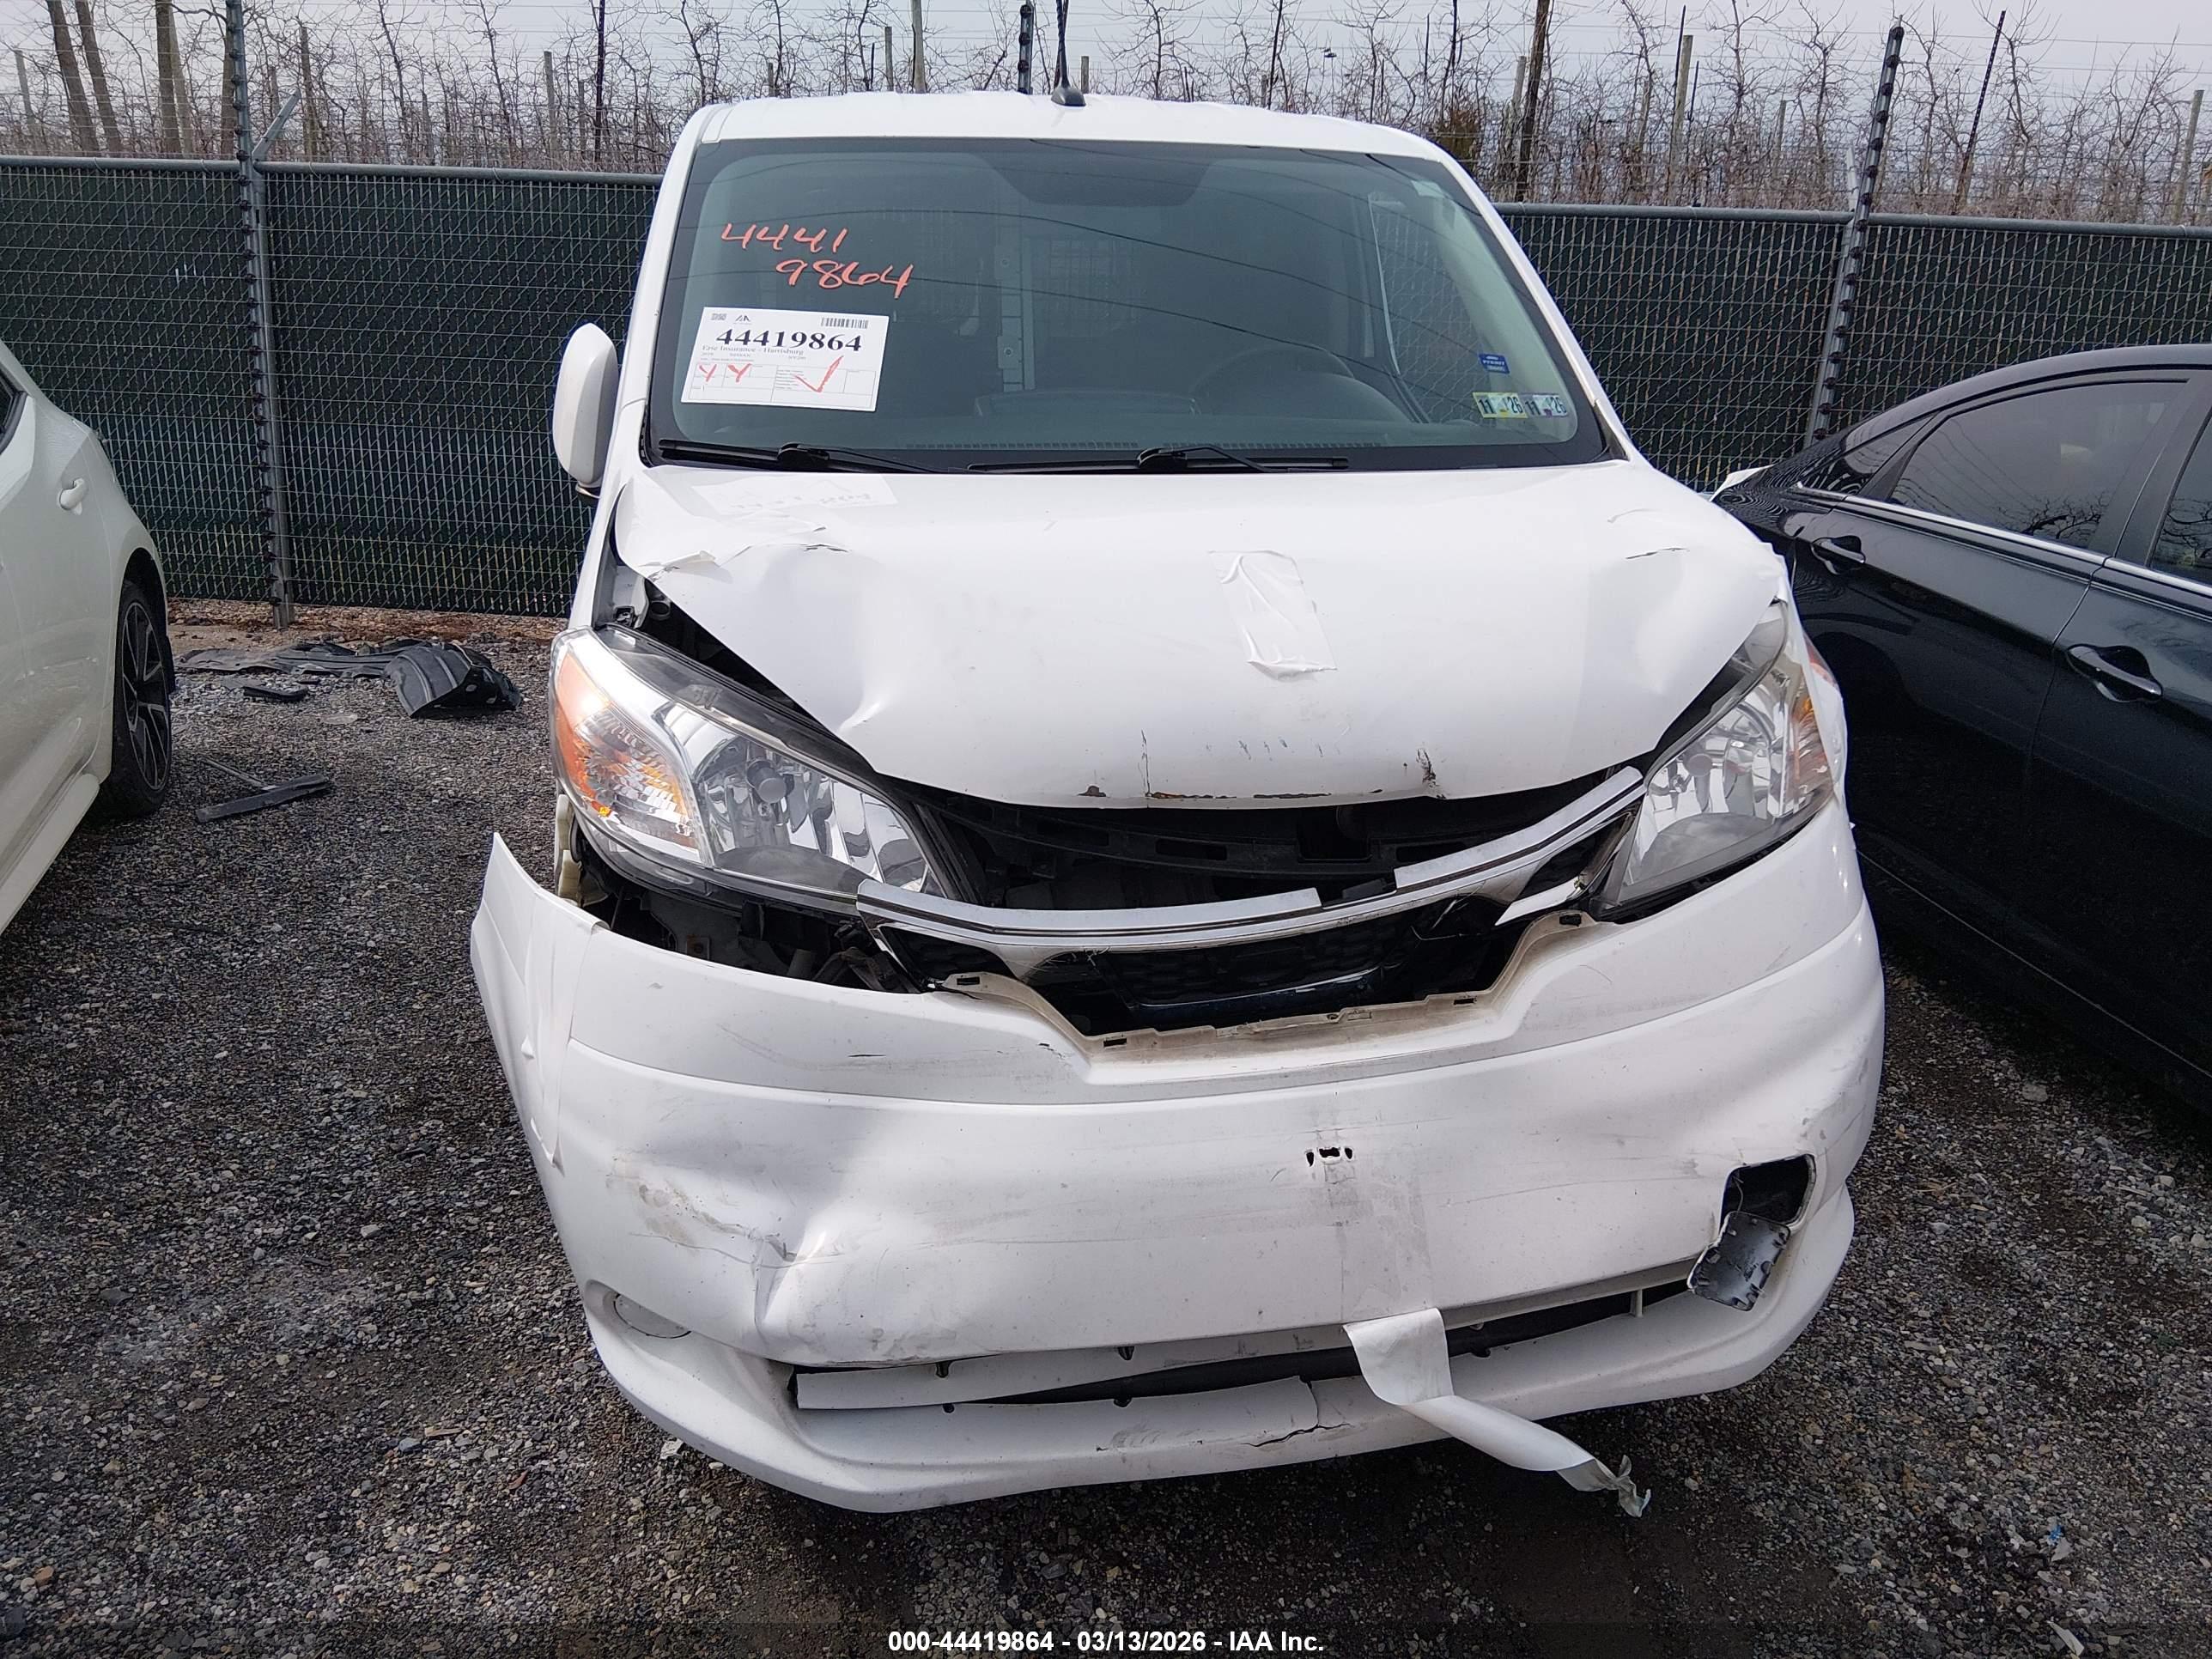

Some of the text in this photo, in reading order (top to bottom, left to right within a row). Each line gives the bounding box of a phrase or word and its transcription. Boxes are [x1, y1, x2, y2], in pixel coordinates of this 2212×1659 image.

[720, 223, 848, 253] 4441
[775, 258, 915, 299] 9864
[715, 328, 862, 352] 44419864
[763, 347, 805, 356] Harrisburg
[1478, 399, 1497, 415] 11
[1524, 400, 1541, 416] 11
